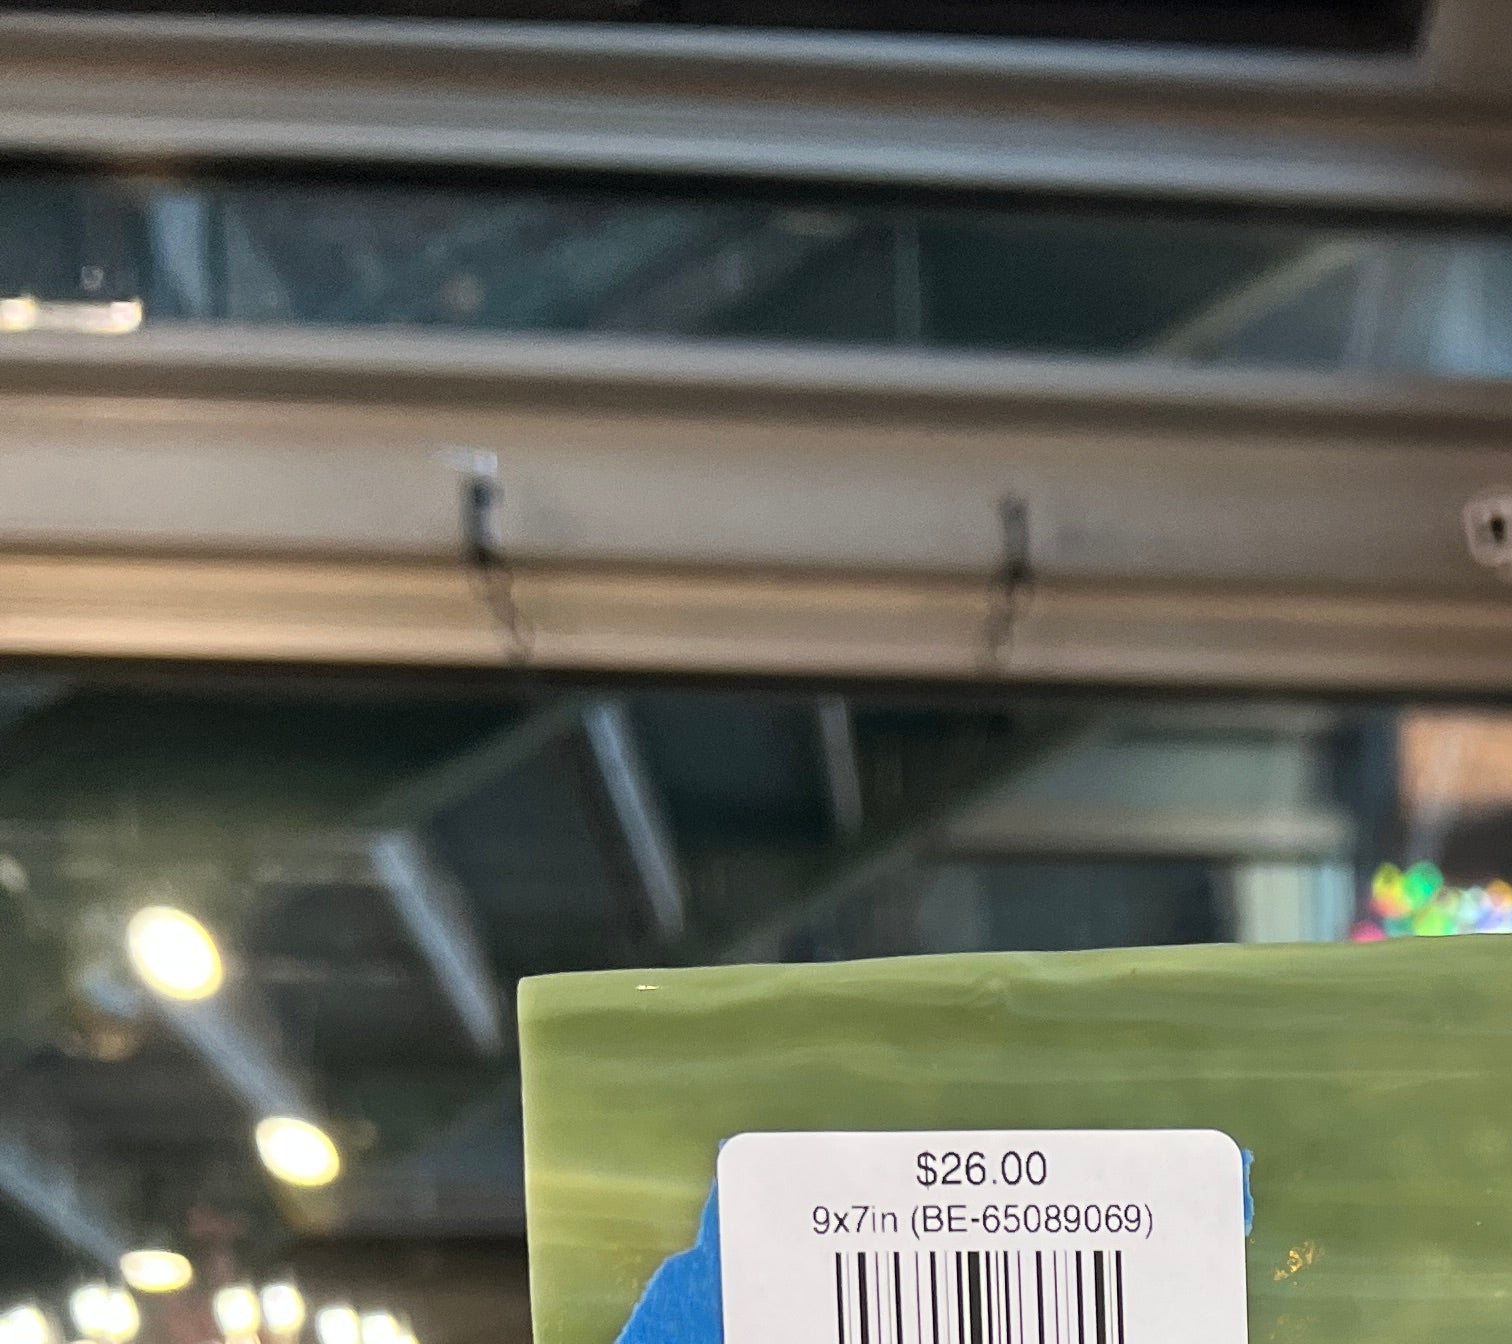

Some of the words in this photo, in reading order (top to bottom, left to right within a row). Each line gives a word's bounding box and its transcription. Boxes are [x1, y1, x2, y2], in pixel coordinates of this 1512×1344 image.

[915, 1149, 1047, 1189] $26.00
[811, 1204, 898, 1235] 9x7in
[910, 1202, 1153, 1241] (BE-65089069)
